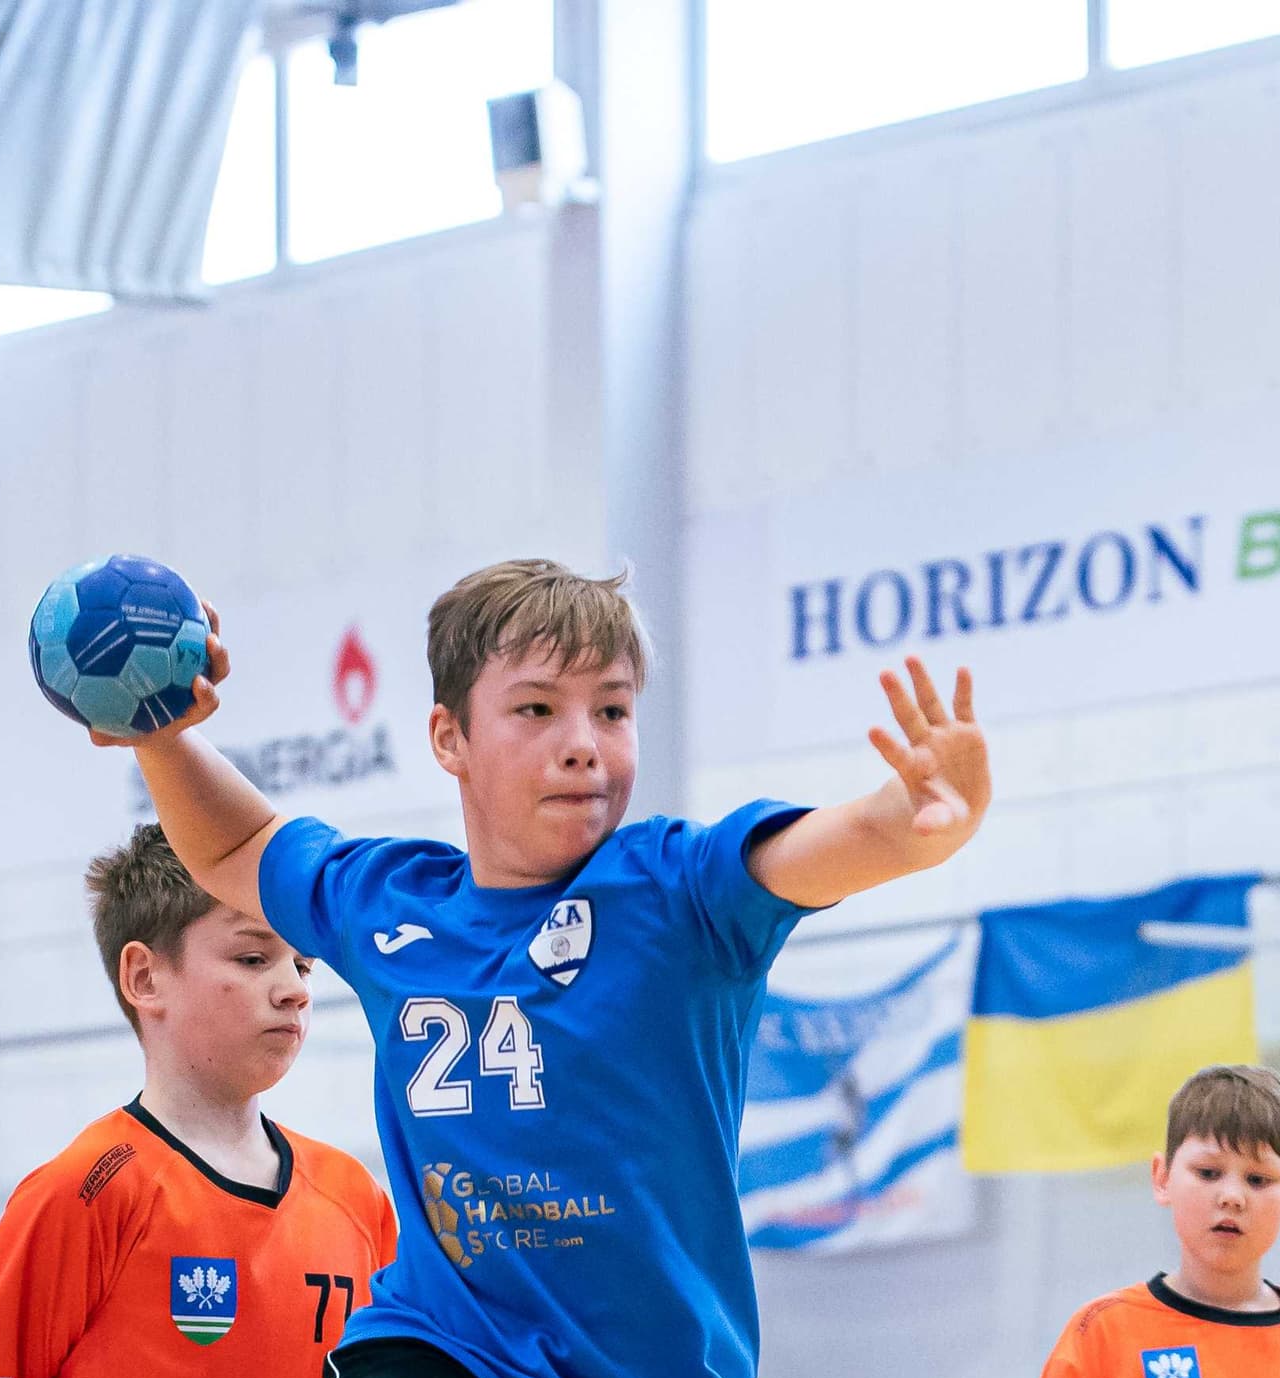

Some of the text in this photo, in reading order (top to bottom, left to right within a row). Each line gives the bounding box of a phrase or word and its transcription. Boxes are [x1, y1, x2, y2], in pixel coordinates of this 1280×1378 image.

[786, 515, 1207, 664] HORIZON
[399, 996, 546, 1118] 24
[78, 1143, 134, 1200] TEAMSHIELD
[463, 1194, 616, 1226] HANDBALL
[305, 1273, 354, 1343] 77
